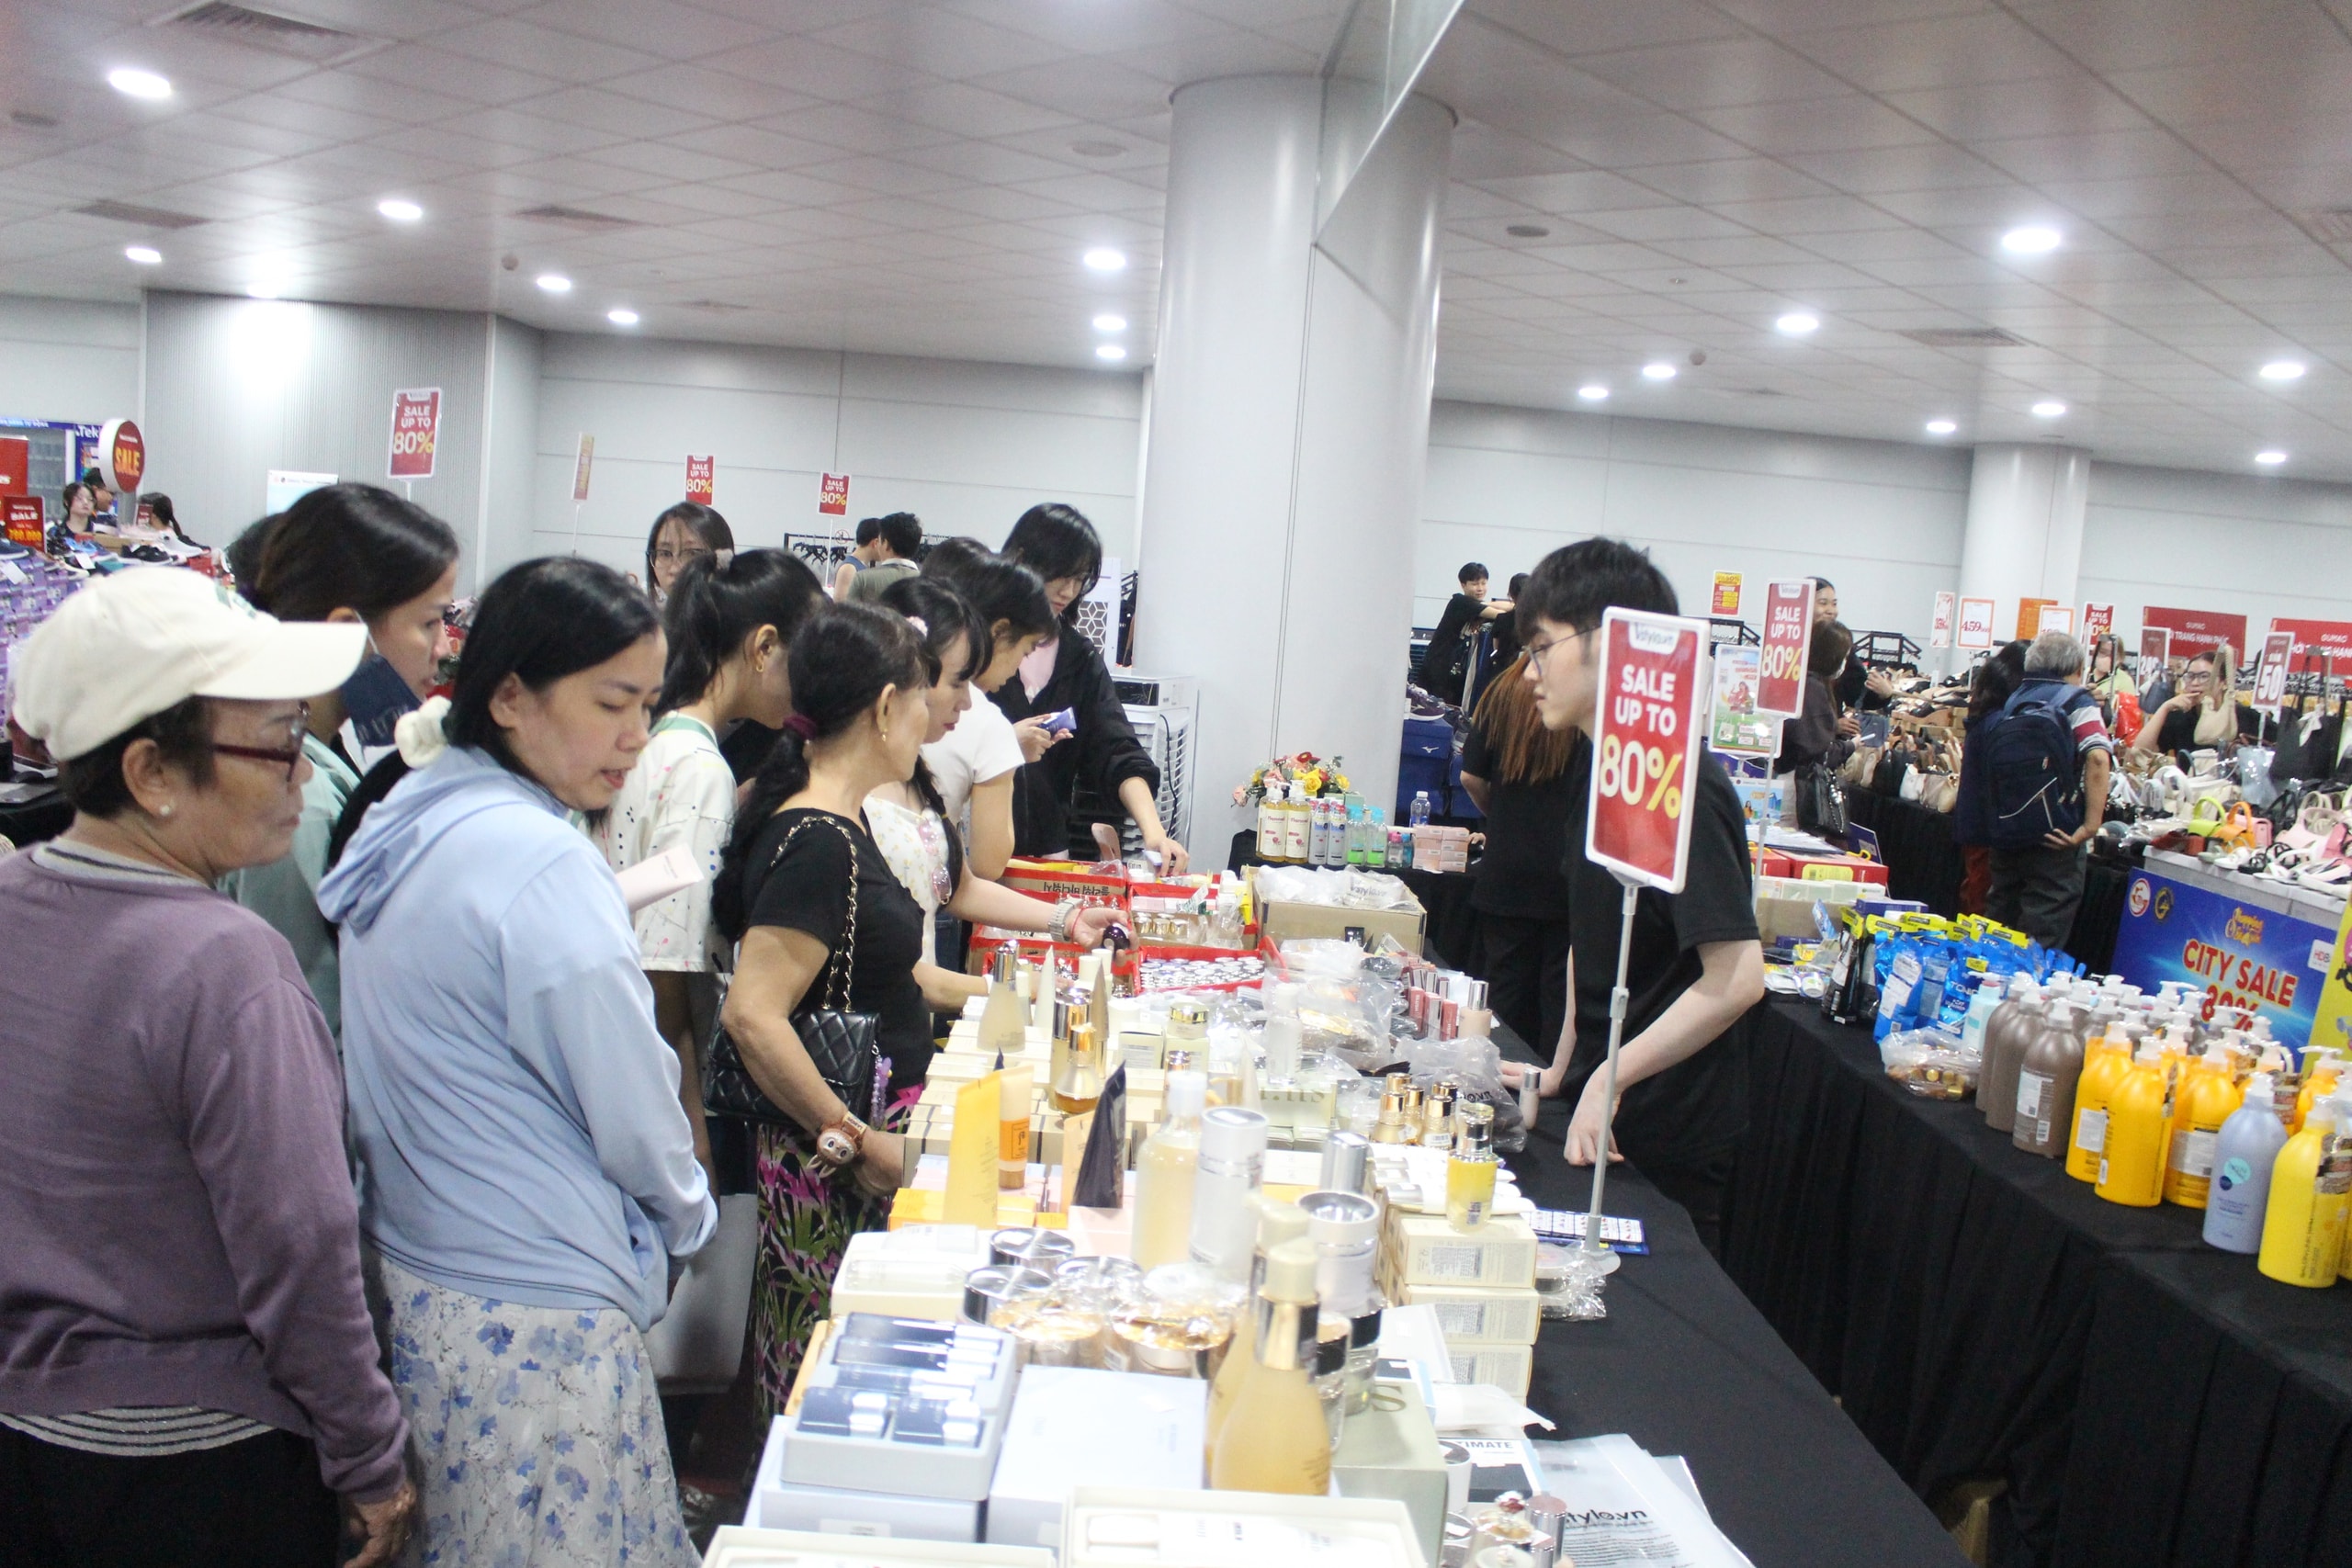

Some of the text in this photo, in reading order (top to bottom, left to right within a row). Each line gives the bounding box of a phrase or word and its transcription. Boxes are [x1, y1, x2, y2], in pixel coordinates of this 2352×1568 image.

[401, 417, 431, 428] UP TO
[404, 406, 430, 417] SALE
[393, 431, 434, 454] 80%
[115, 446, 140, 477] SALE
[686, 479, 712, 493] 80%
[827, 479, 843, 488] SALE
[820, 491, 846, 505] 80%
[1775, 606, 1800, 623] SALE
[1770, 623, 1801, 639] UP TO
[1761, 644, 1801, 682] 80%
[1622, 664, 1676, 703] SALE
[2257, 664, 2284, 701] 50
[1615, 695, 1677, 736] UP TO
[1600, 734, 1682, 818] 80%
[2183, 938, 2298, 1009] CITY SALE
